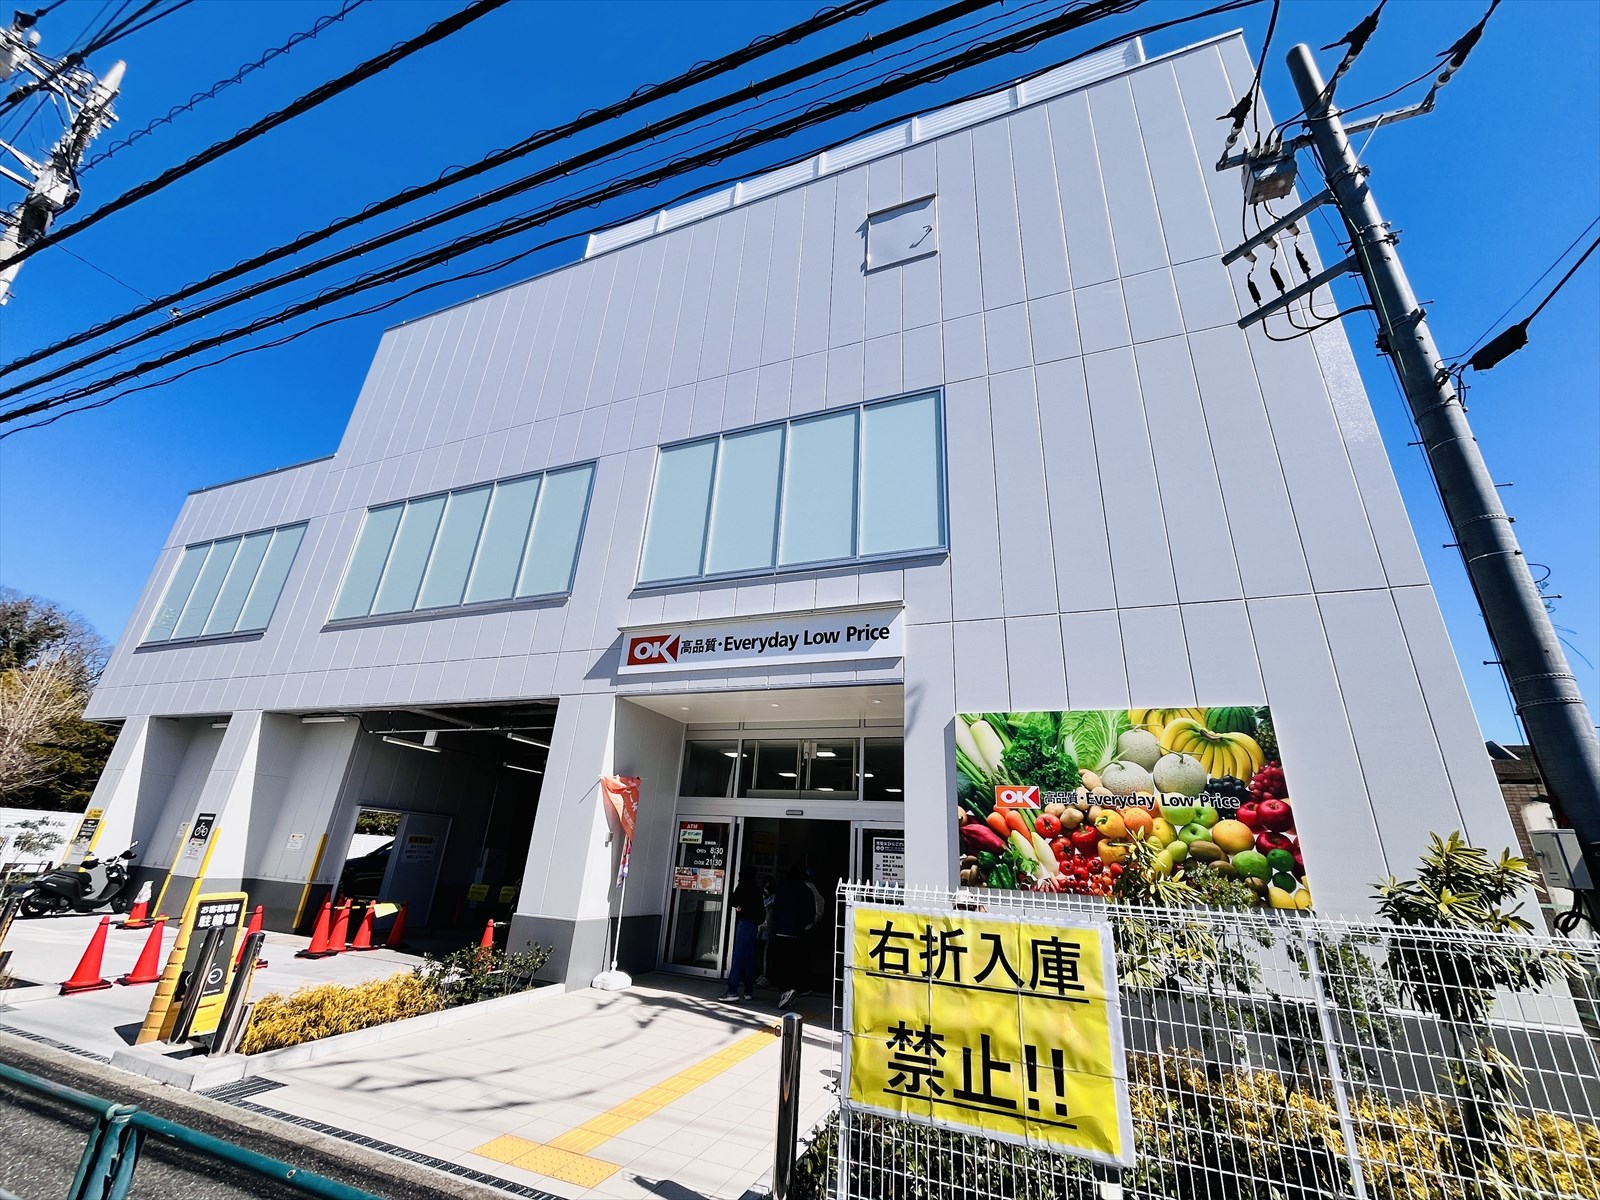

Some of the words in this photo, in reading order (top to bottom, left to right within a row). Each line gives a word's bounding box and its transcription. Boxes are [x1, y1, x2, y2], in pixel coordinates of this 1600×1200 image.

[803, 628, 839, 646] Low
[846, 623, 890, 642] Price
[633, 636, 678, 663] OK
[999, 787, 1038, 808] OK
[1161, 793, 1194, 807] Low
[1200, 793, 1240, 809] Price
[709, 847, 724, 855] 8:30
[869, 920, 1085, 995] 右折入庫
